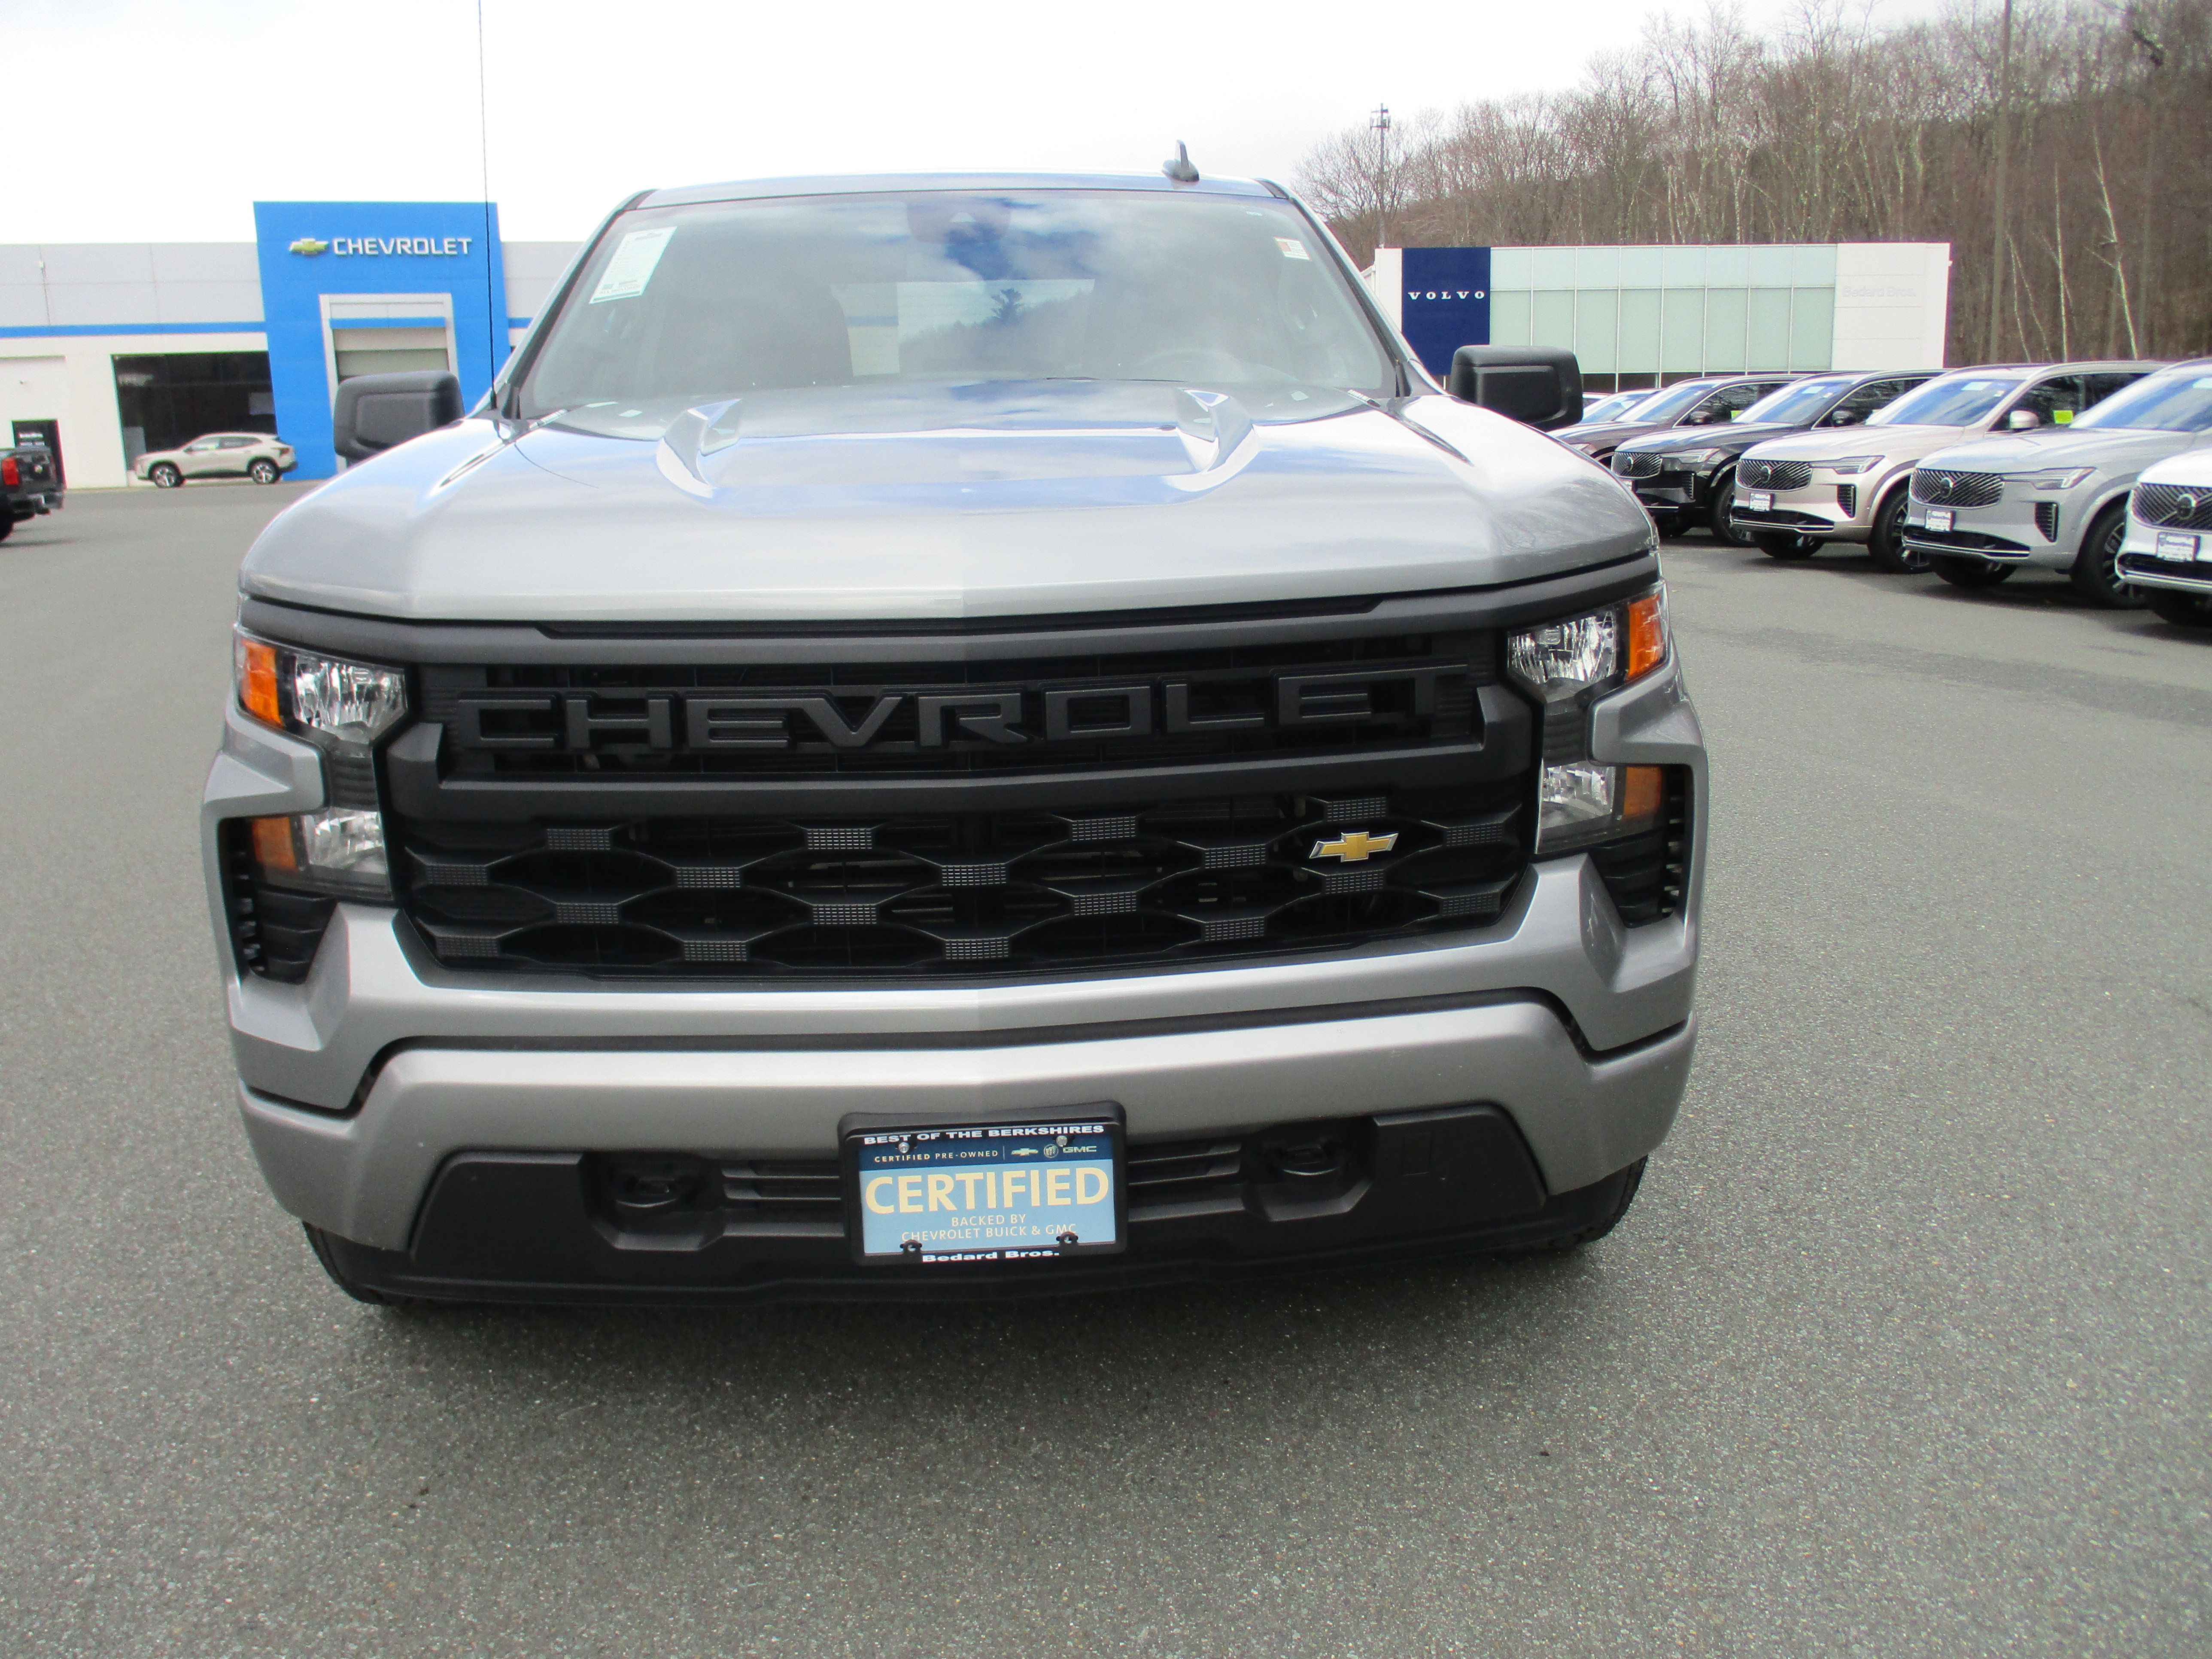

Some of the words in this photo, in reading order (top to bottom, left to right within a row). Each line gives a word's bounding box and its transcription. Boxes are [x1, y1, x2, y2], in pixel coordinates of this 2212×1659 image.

[332, 237, 472, 255] CHEVROLET
[1407, 291, 1485, 300] VOLVO
[458, 660, 1469, 749] CHEVROLET
[864, 1134, 911, 1145] BEST
[916, 1132, 941, 1141] OF
[945, 1130, 983, 1139] THE
[988, 1125, 1105, 1137] BERKSHIRES
[874, 1154, 930, 1163] CERTIFIED
[935, 1150, 998, 1159] PRE-OWNED
[1062, 1146, 1097, 1154] GMC
[865, 1167, 1109, 1214] CERTIFIED
[951, 1215, 1005, 1227] BACKED
[1010, 1214, 1026, 1224] BY
[902, 1228, 981, 1242] CHEVROLET
[986, 1226, 1027, 1237] BUICK
[1031, 1225, 1041, 1235] &
[1045, 1224, 1076, 1235] GMC
[922, 1251, 998, 1263] Bedard
[1005, 1249, 1060, 1259] Bros.
